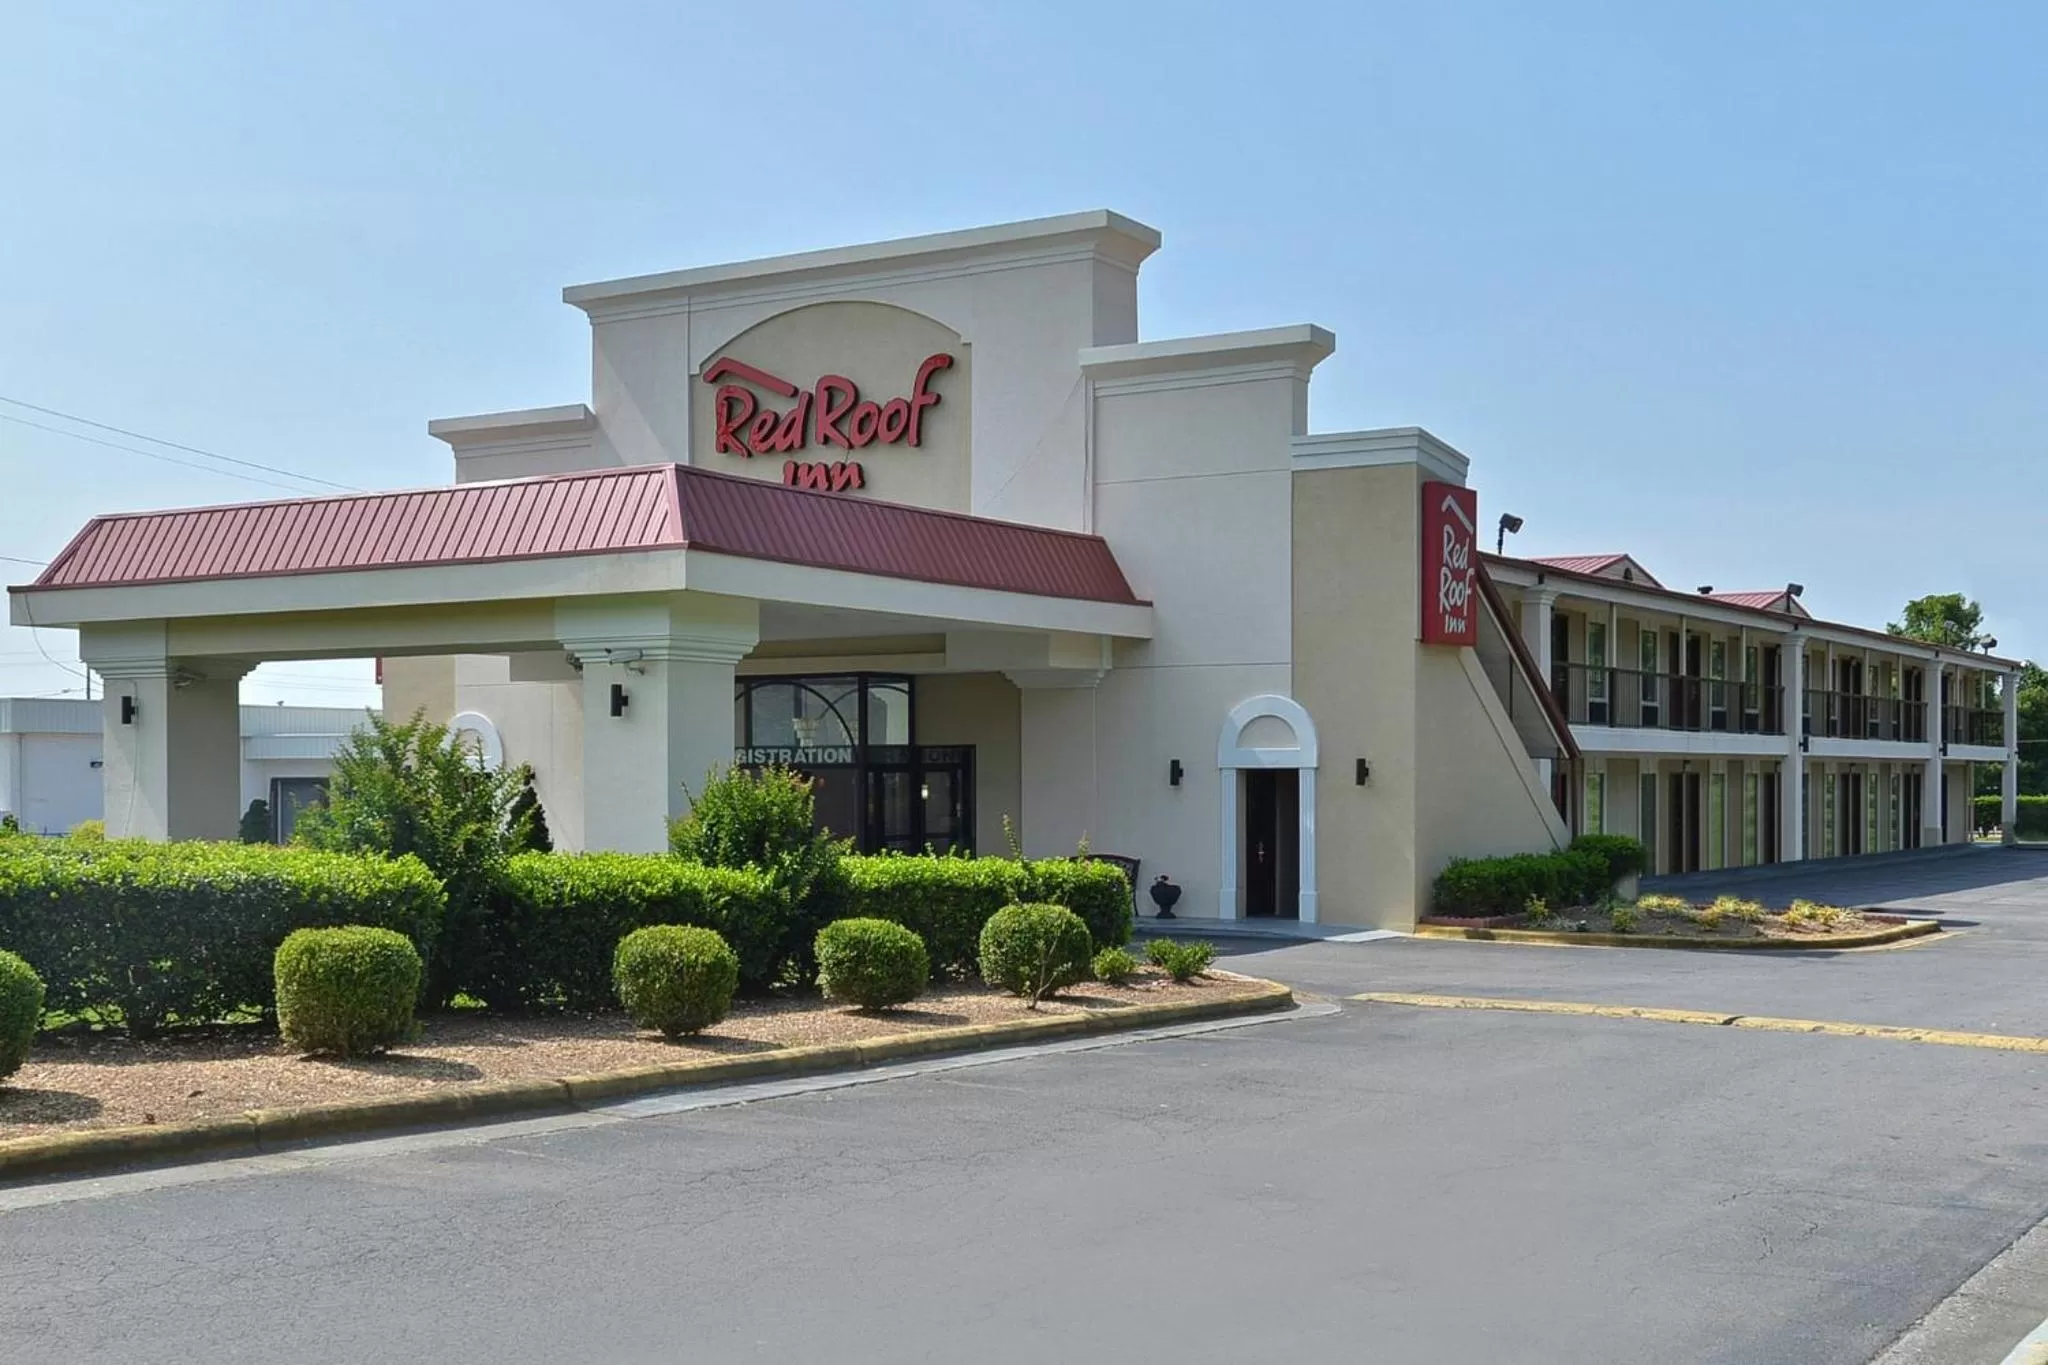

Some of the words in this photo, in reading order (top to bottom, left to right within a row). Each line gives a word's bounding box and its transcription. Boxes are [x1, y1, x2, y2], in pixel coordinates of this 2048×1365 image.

[715, 384, 813, 458] Red
[815, 353, 954, 450] Roof
[1443, 525, 1470, 569] Red
[1440, 567, 1474, 616] Roof
